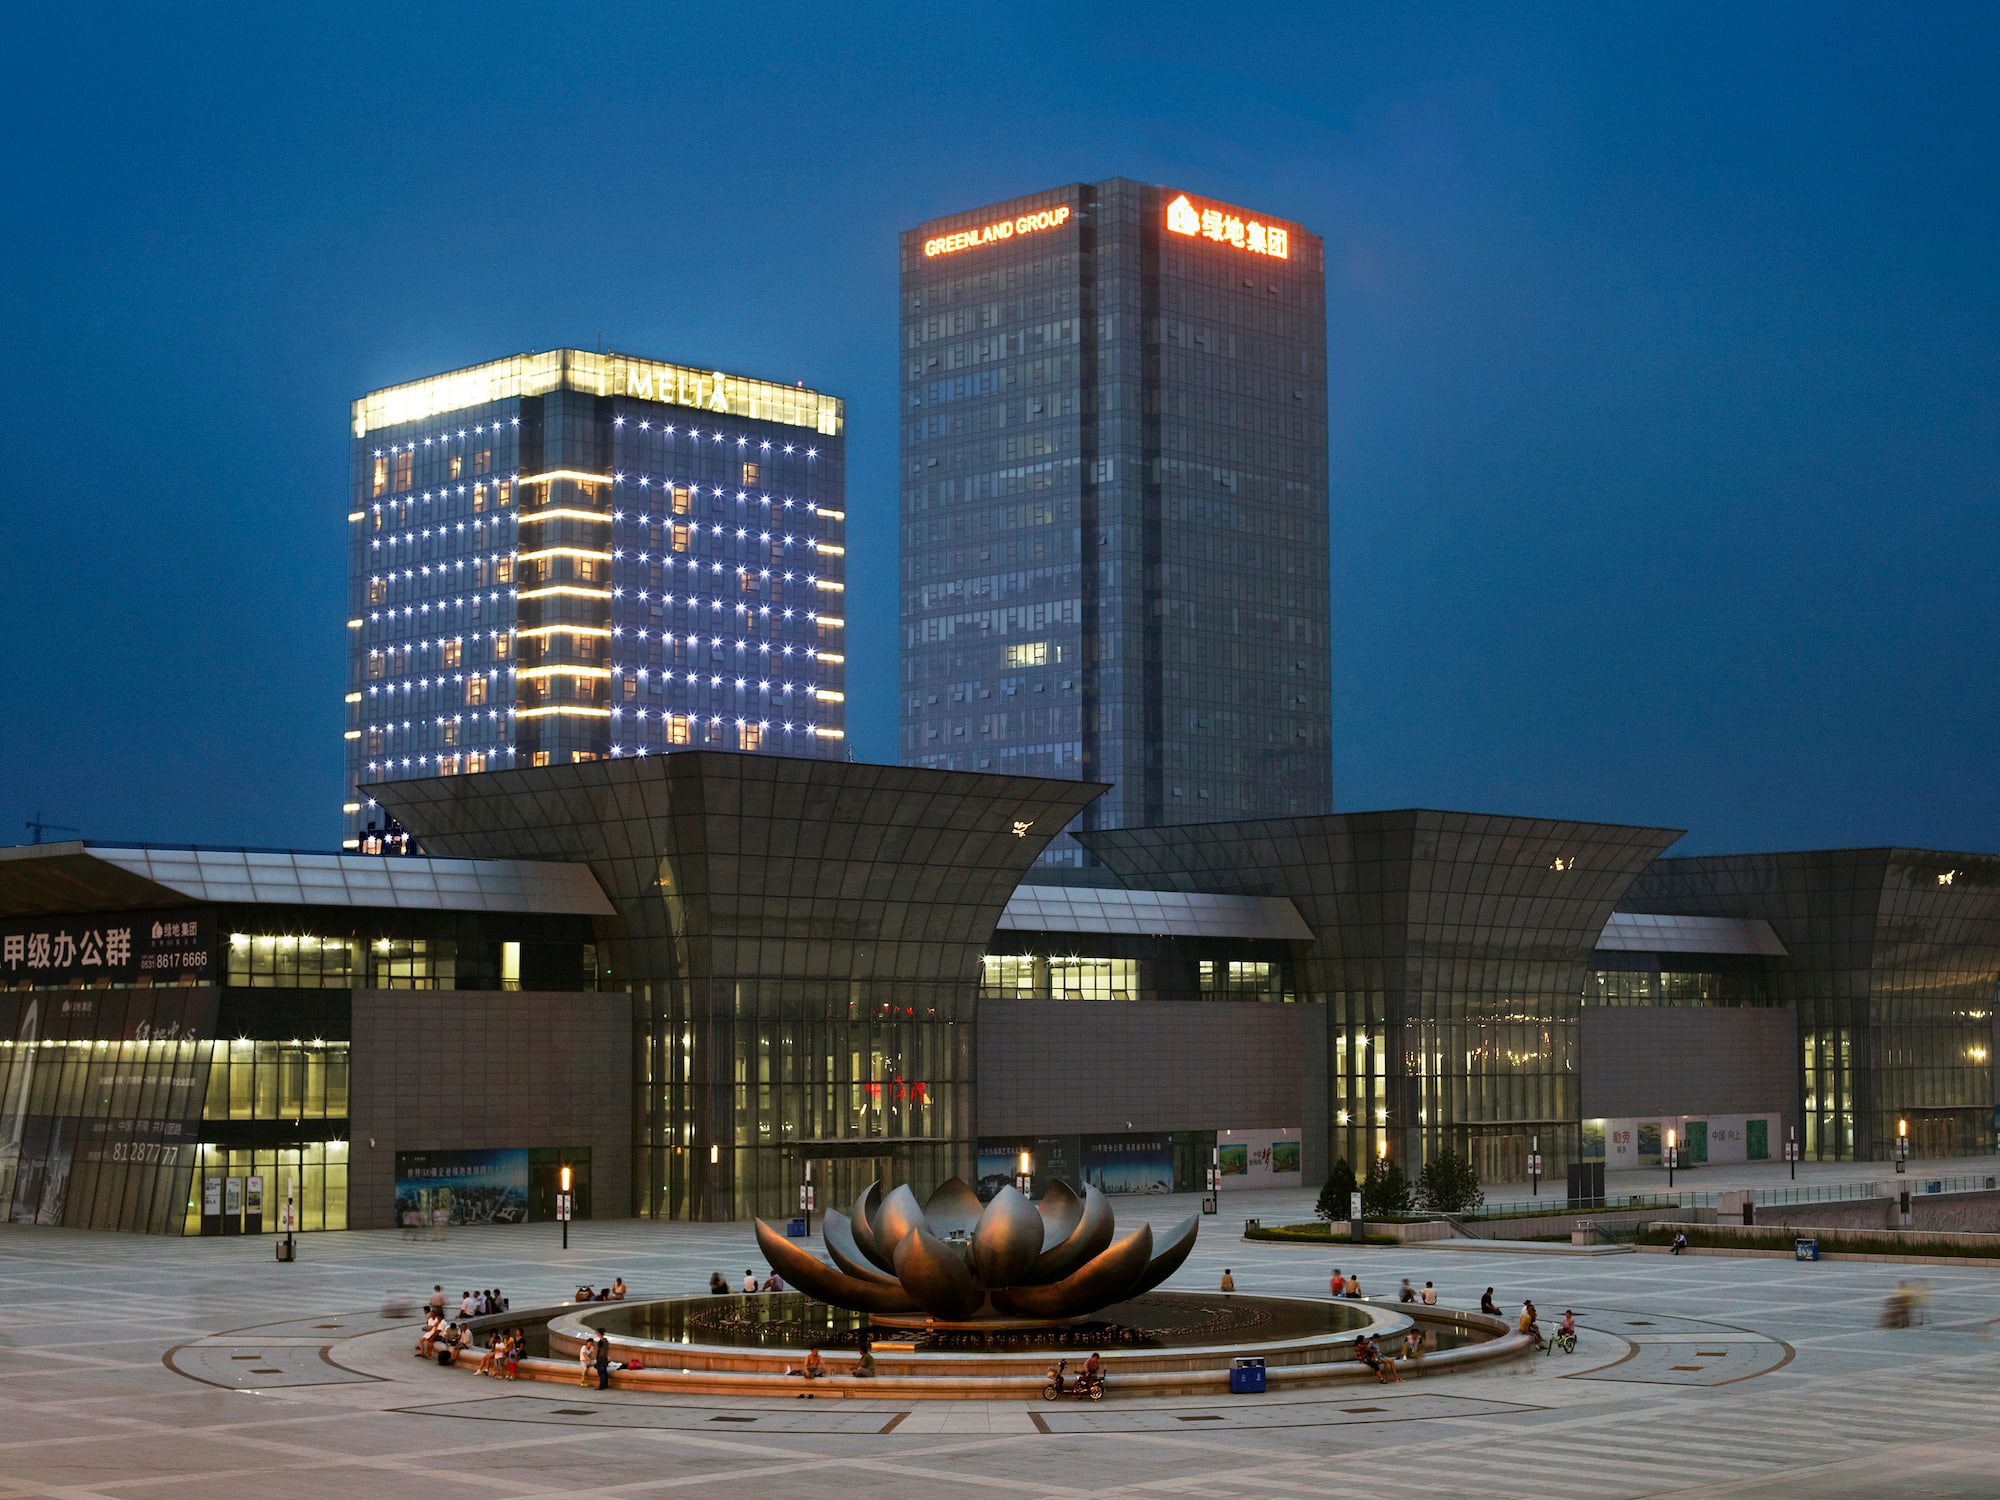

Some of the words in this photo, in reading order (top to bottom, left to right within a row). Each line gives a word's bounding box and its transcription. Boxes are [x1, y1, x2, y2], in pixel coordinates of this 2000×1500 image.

[924, 221, 1013, 256] GREENLAND
[1016, 206, 1070, 234] GROUP
[1201, 208, 1288, 260] 绿地集团
[3, 927, 132, 971] 甲级办公群
[163, 921, 198, 938] 绿地集团
[156, 952, 181, 969] 8617
[182, 950, 208, 967] 6666
